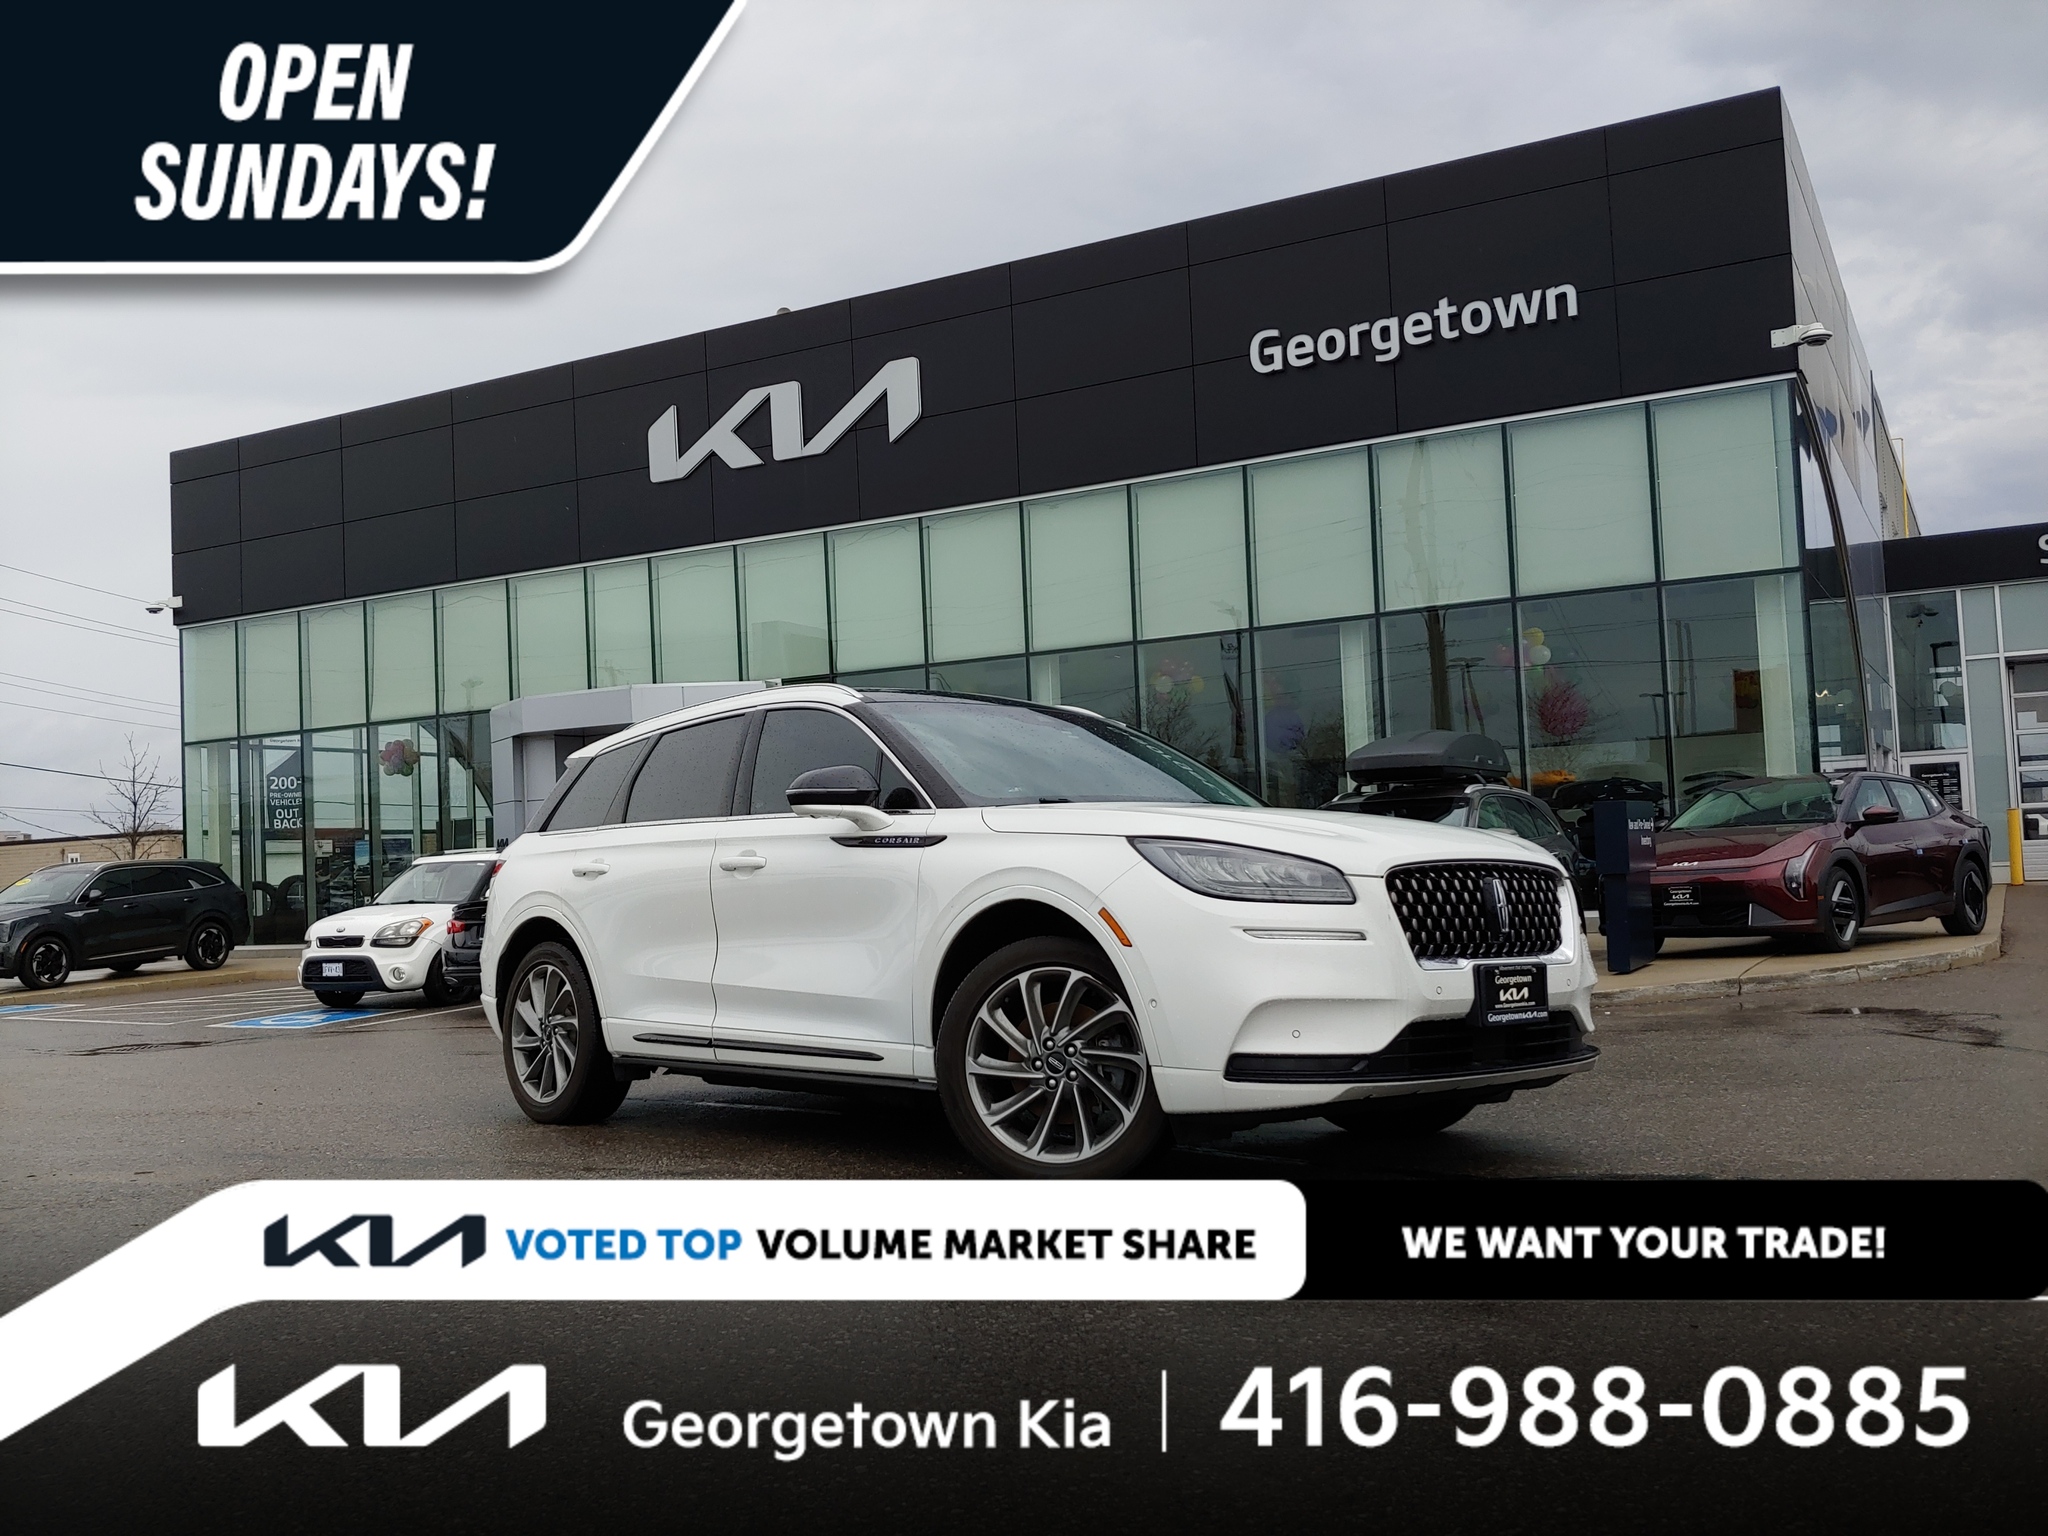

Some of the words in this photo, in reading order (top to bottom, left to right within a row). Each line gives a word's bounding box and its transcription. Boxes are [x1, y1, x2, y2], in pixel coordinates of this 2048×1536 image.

[1249, 283, 1579, 374] Georgetown
[648, 356, 922, 484] KIA
[275, 808, 300, 819] OUT
[273, 818, 303, 829] BACK
[1494, 975, 1533, 985] Georgetown
[1499, 986, 1530, 1002] KIA
